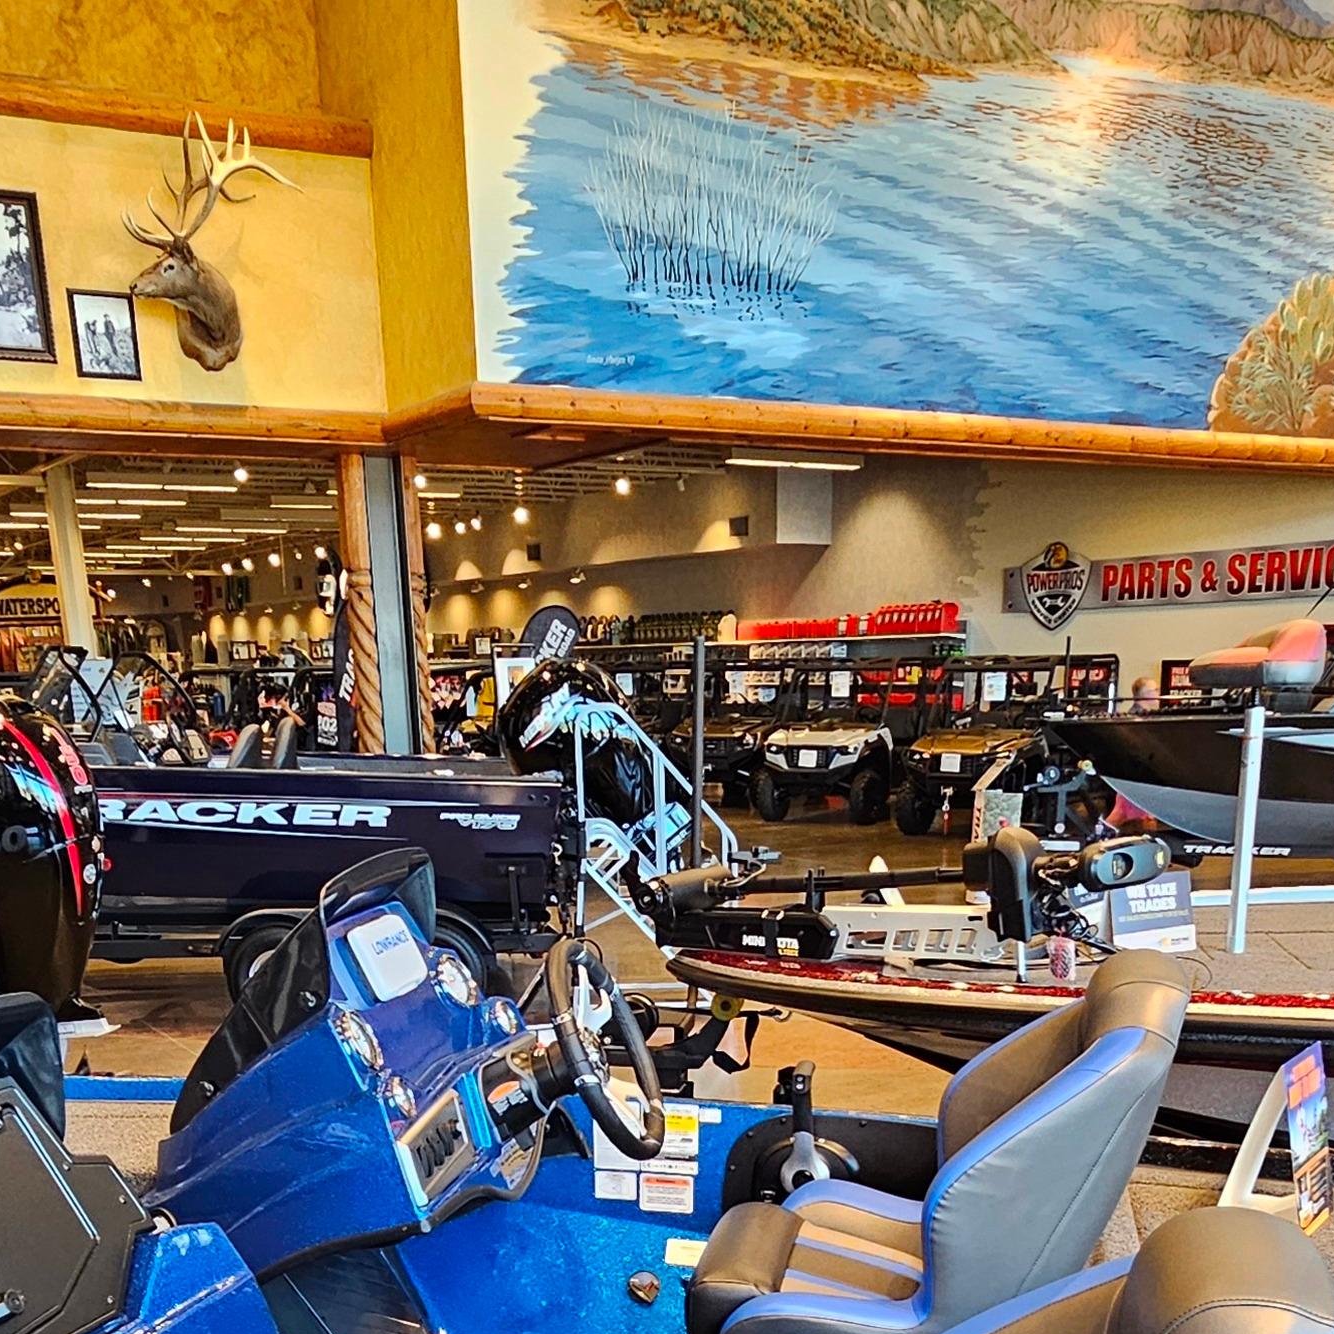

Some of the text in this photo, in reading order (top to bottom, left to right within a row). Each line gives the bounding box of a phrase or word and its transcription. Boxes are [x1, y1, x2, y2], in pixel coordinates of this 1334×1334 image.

[1101, 557, 1193, 602] PARTS
[1199, 561, 1220, 592] &
[1146, 882, 1177, 898] TAKE
[1129, 896, 1177, 914] TRADES
